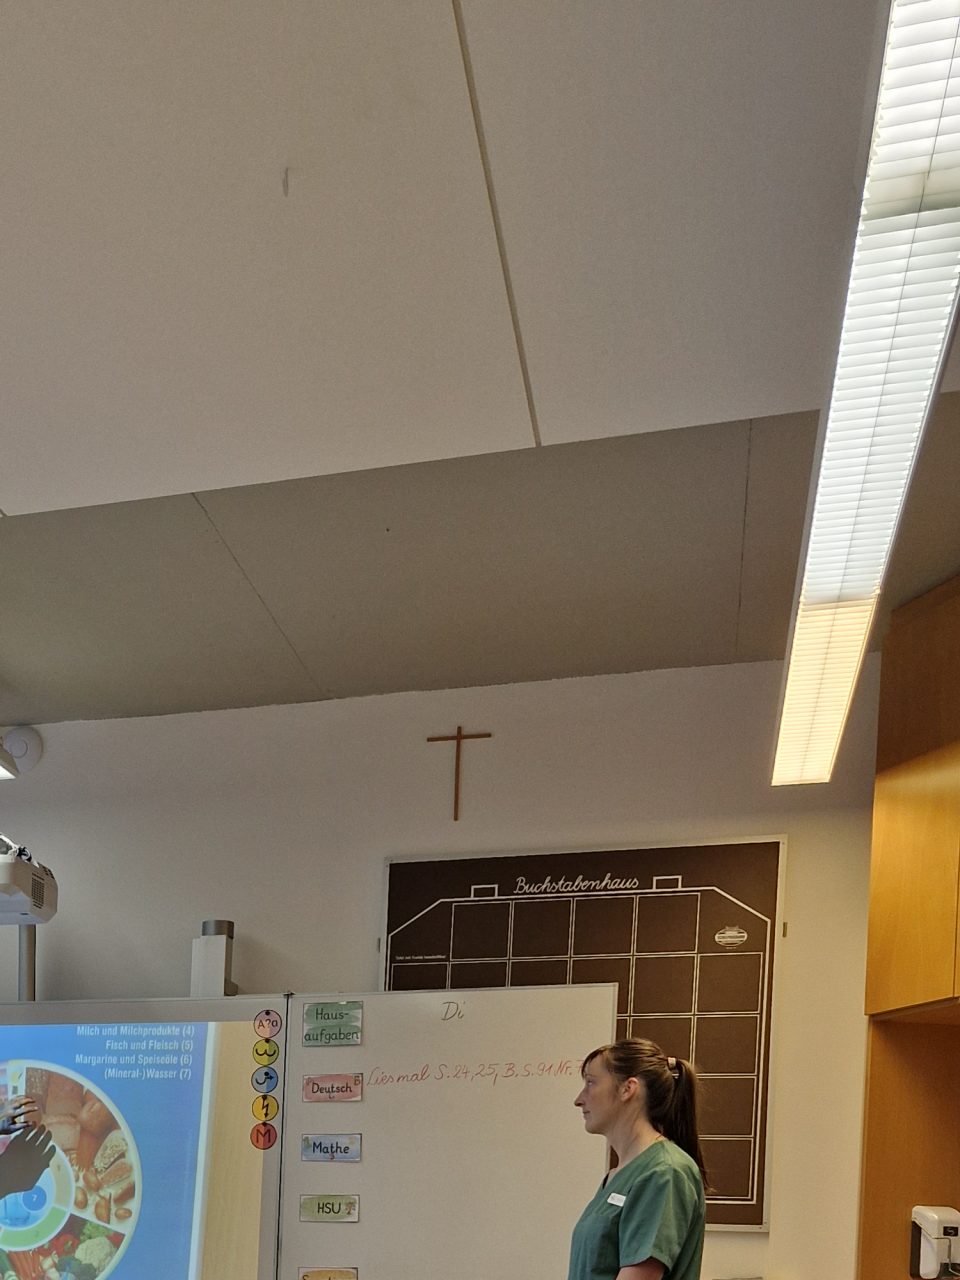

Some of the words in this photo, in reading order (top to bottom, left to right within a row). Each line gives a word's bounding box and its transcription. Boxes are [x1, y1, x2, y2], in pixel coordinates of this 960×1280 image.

[513, 872, 639, 894] Buchstabenhaus
[315, 1008, 349, 1020] Haus-
[441, 1001, 466, 1021] Di
[76, 1026, 100, 1036] Milch
[102, 1026, 117, 1036] und
[120, 1025, 180, 1037] Milchprodukte
[182, 1025, 195, 1037] (4)
[304, 1028, 359, 1044] aufgaben
[105, 1040, 128, 1050] Fisch
[130, 1040, 146, 1050] und
[148, 1040, 178, 1050] Fleisch
[181, 1040, 194, 1052] (5)
[75, 1054, 119, 1065] Margarine
[120, 1054, 136, 1064] und
[137, 1054, 178, 1065] Speiseöle
[180, 1054, 193, 1066] (6)
[179, 1069, 192, 1080] (7)
[311, 1081, 353, 1094] Deutsch
[312, 1141, 350, 1154] Mathe
[317, 1202, 342, 1214] HSU
